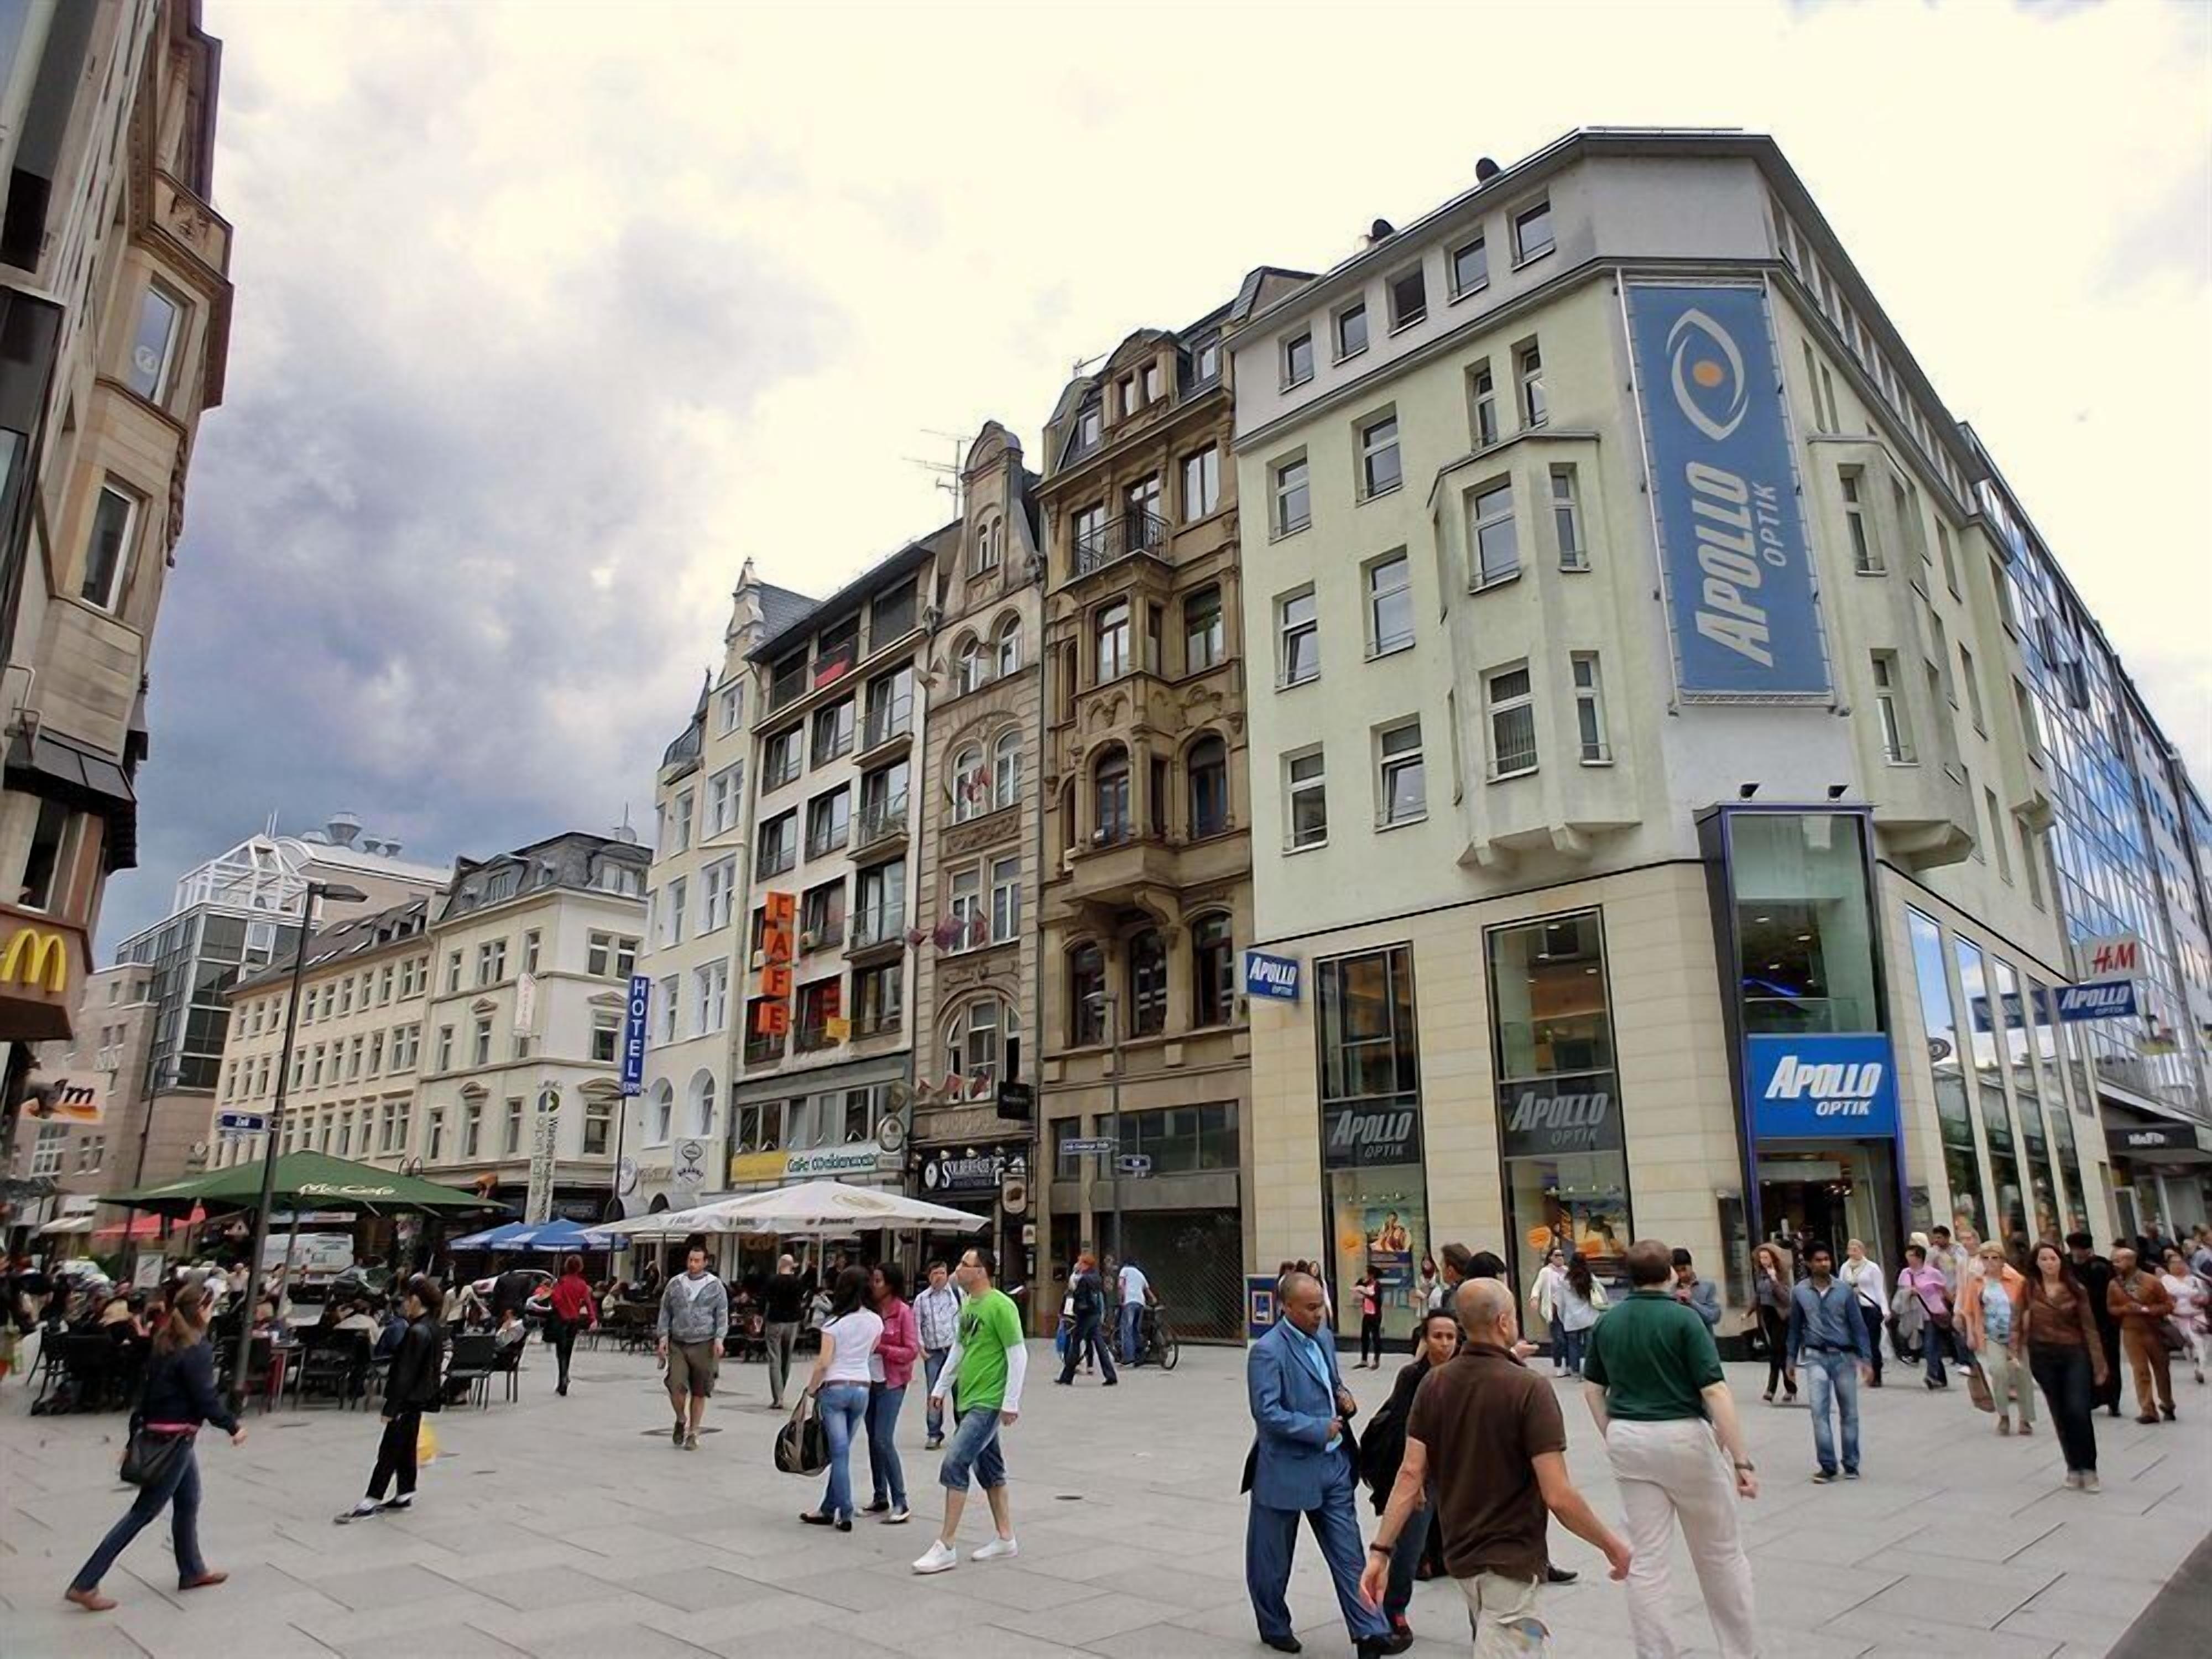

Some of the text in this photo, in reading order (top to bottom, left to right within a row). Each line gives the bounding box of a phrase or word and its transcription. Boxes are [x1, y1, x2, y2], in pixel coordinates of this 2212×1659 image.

[1752, 481, 1788, 567] OPTIK
[1684, 460, 1774, 668] APOLLO
[1249, 956, 1297, 985] APOLLO
[2092, 942, 2135, 974] H&M
[2060, 985, 2129, 1009] APOLLO
[627, 979, 647, 1078] HOTEL
[1764, 1055, 1883, 1099] APOLLO
[1509, 1091, 1609, 1131] APOLLO
[1815, 1100, 1872, 1116] OPTIK
[1331, 1109, 1413, 1146] APOLLO
[1551, 1128, 1598, 1147] OPTIK
[1364, 1143, 1404, 1159] OPTIK
